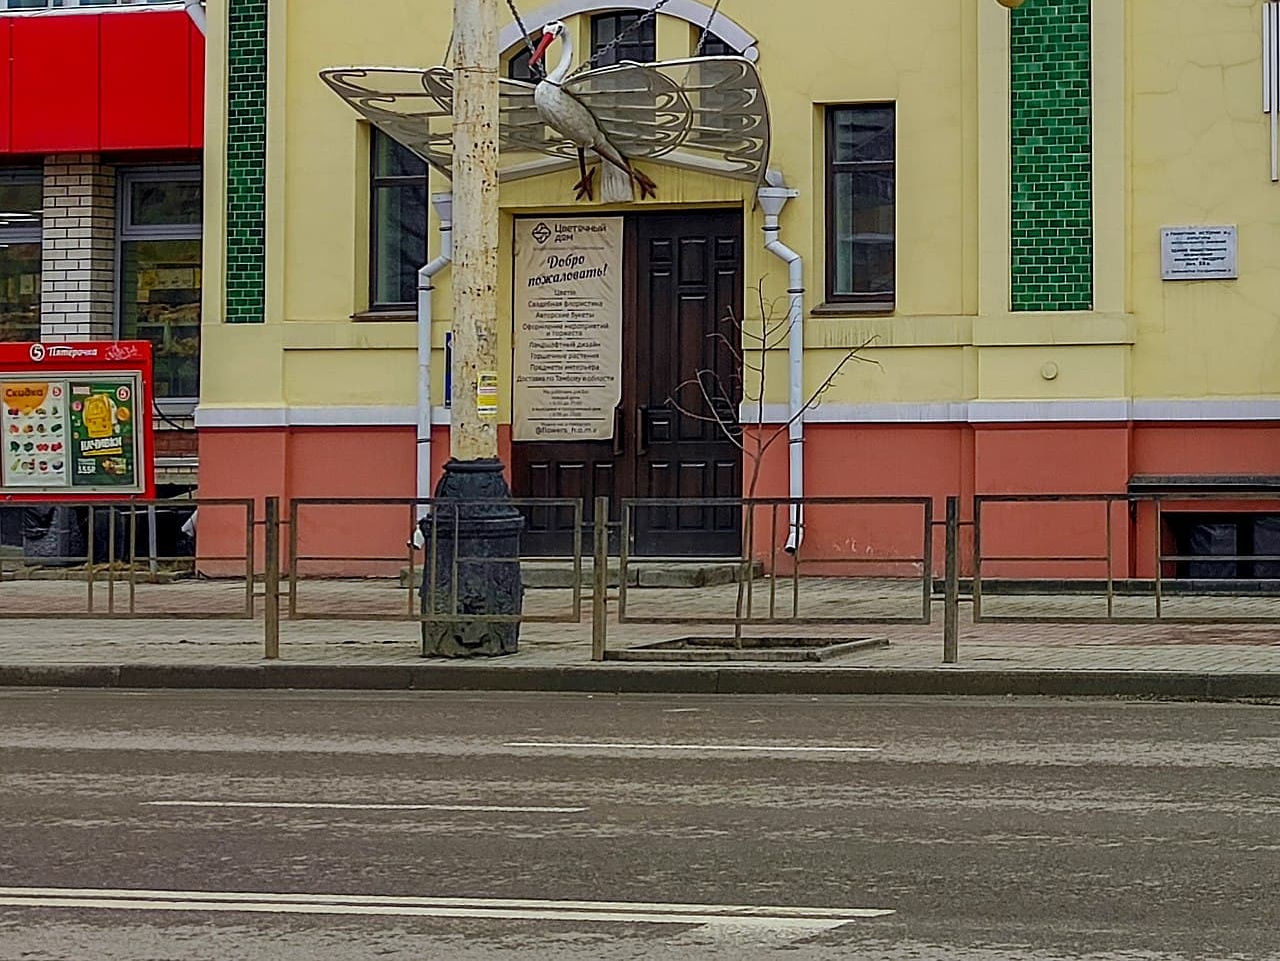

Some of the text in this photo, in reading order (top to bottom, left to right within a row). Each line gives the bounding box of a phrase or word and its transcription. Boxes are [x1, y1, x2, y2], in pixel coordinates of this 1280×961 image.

[554, 223, 607, 234] Цветочный
[554, 234, 574, 243] дом
[547, 254, 585, 270] Добро
[527, 263, 608, 288] пожаловать!
[5, 387, 44, 397] Скидка
